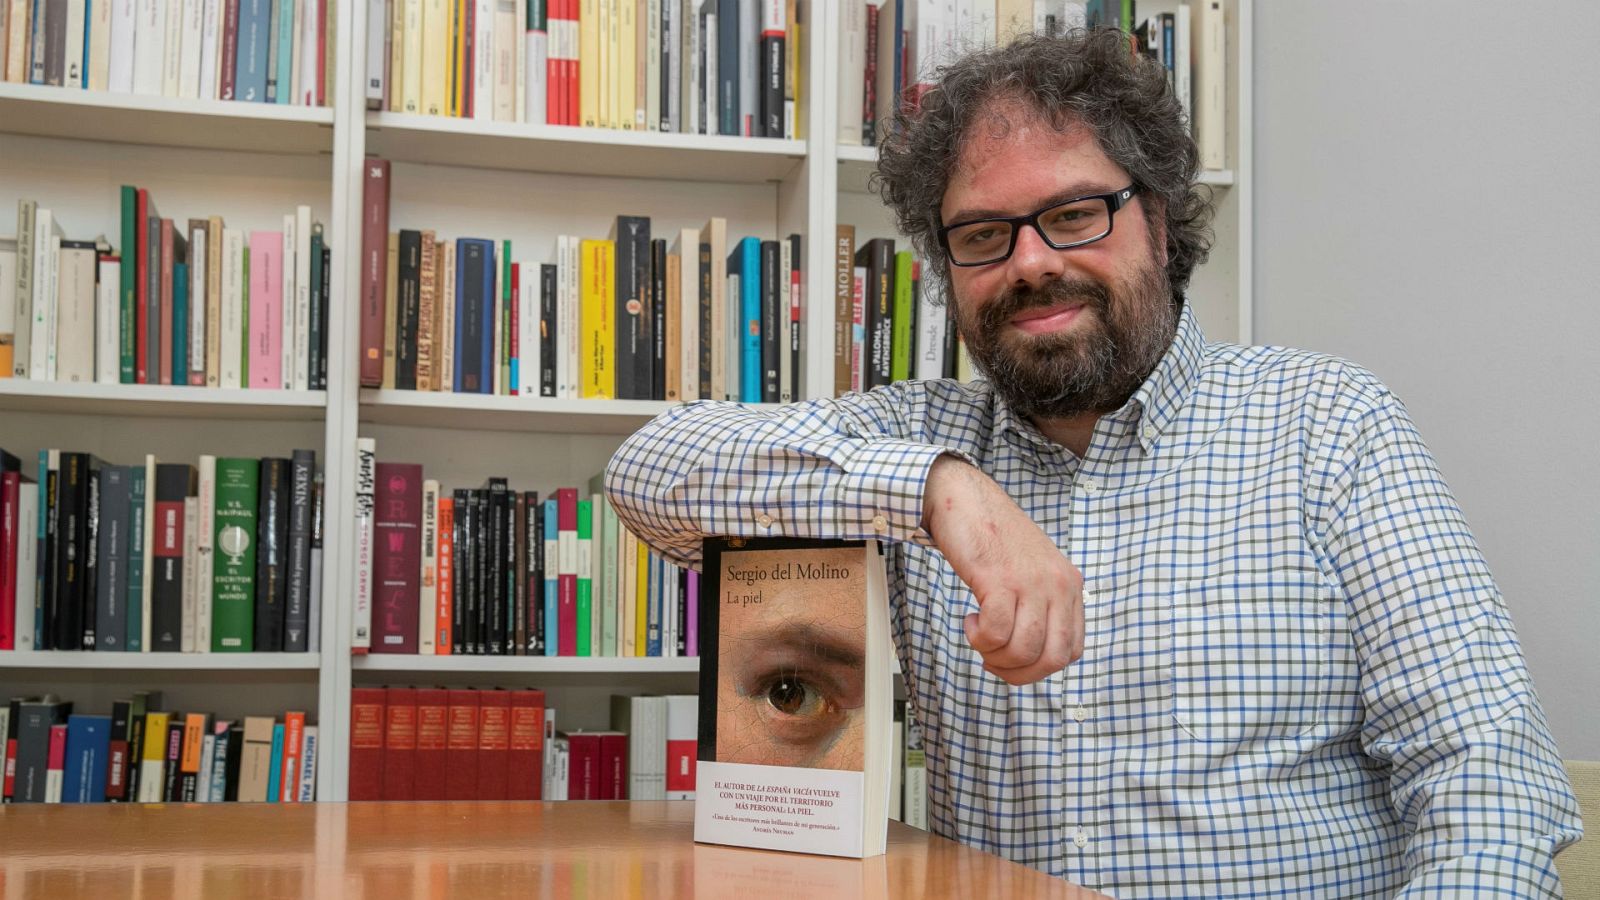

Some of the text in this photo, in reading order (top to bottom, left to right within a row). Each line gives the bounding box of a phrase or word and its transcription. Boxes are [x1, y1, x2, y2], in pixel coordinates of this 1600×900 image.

[838, 237, 850, 297] MOLLER
[873, 329, 882, 364] PALOMA
[881, 318, 892, 377] RAVENSBRÜCK
[926, 325, 938, 361] Dresde
[295, 464, 308, 506] NIXEY
[216, 509, 253, 518] NAIPAUL
[358, 569, 368, 613] ORWELL
[726, 562, 850, 586] Sergio del Molino
[727, 590, 762, 608] La piel
[303, 735, 315, 781] MICHAEL
[714, 781, 723, 789] EL
[723, 783, 745, 791] AUTOR
[746, 784, 756, 792] DE
[766, 785, 791, 794] ESPAÑA
[813, 789, 841, 798] VUELVE
[719, 791, 734, 799] CON
[745, 793, 764, 802] VIAJE
[765, 795, 779, 803] POR
[780, 796, 789, 804] EL
[790, 797, 833, 808] TERRITORIO
[735, 801, 815, 816] MÁS PERSONAL: LA PIEL.
